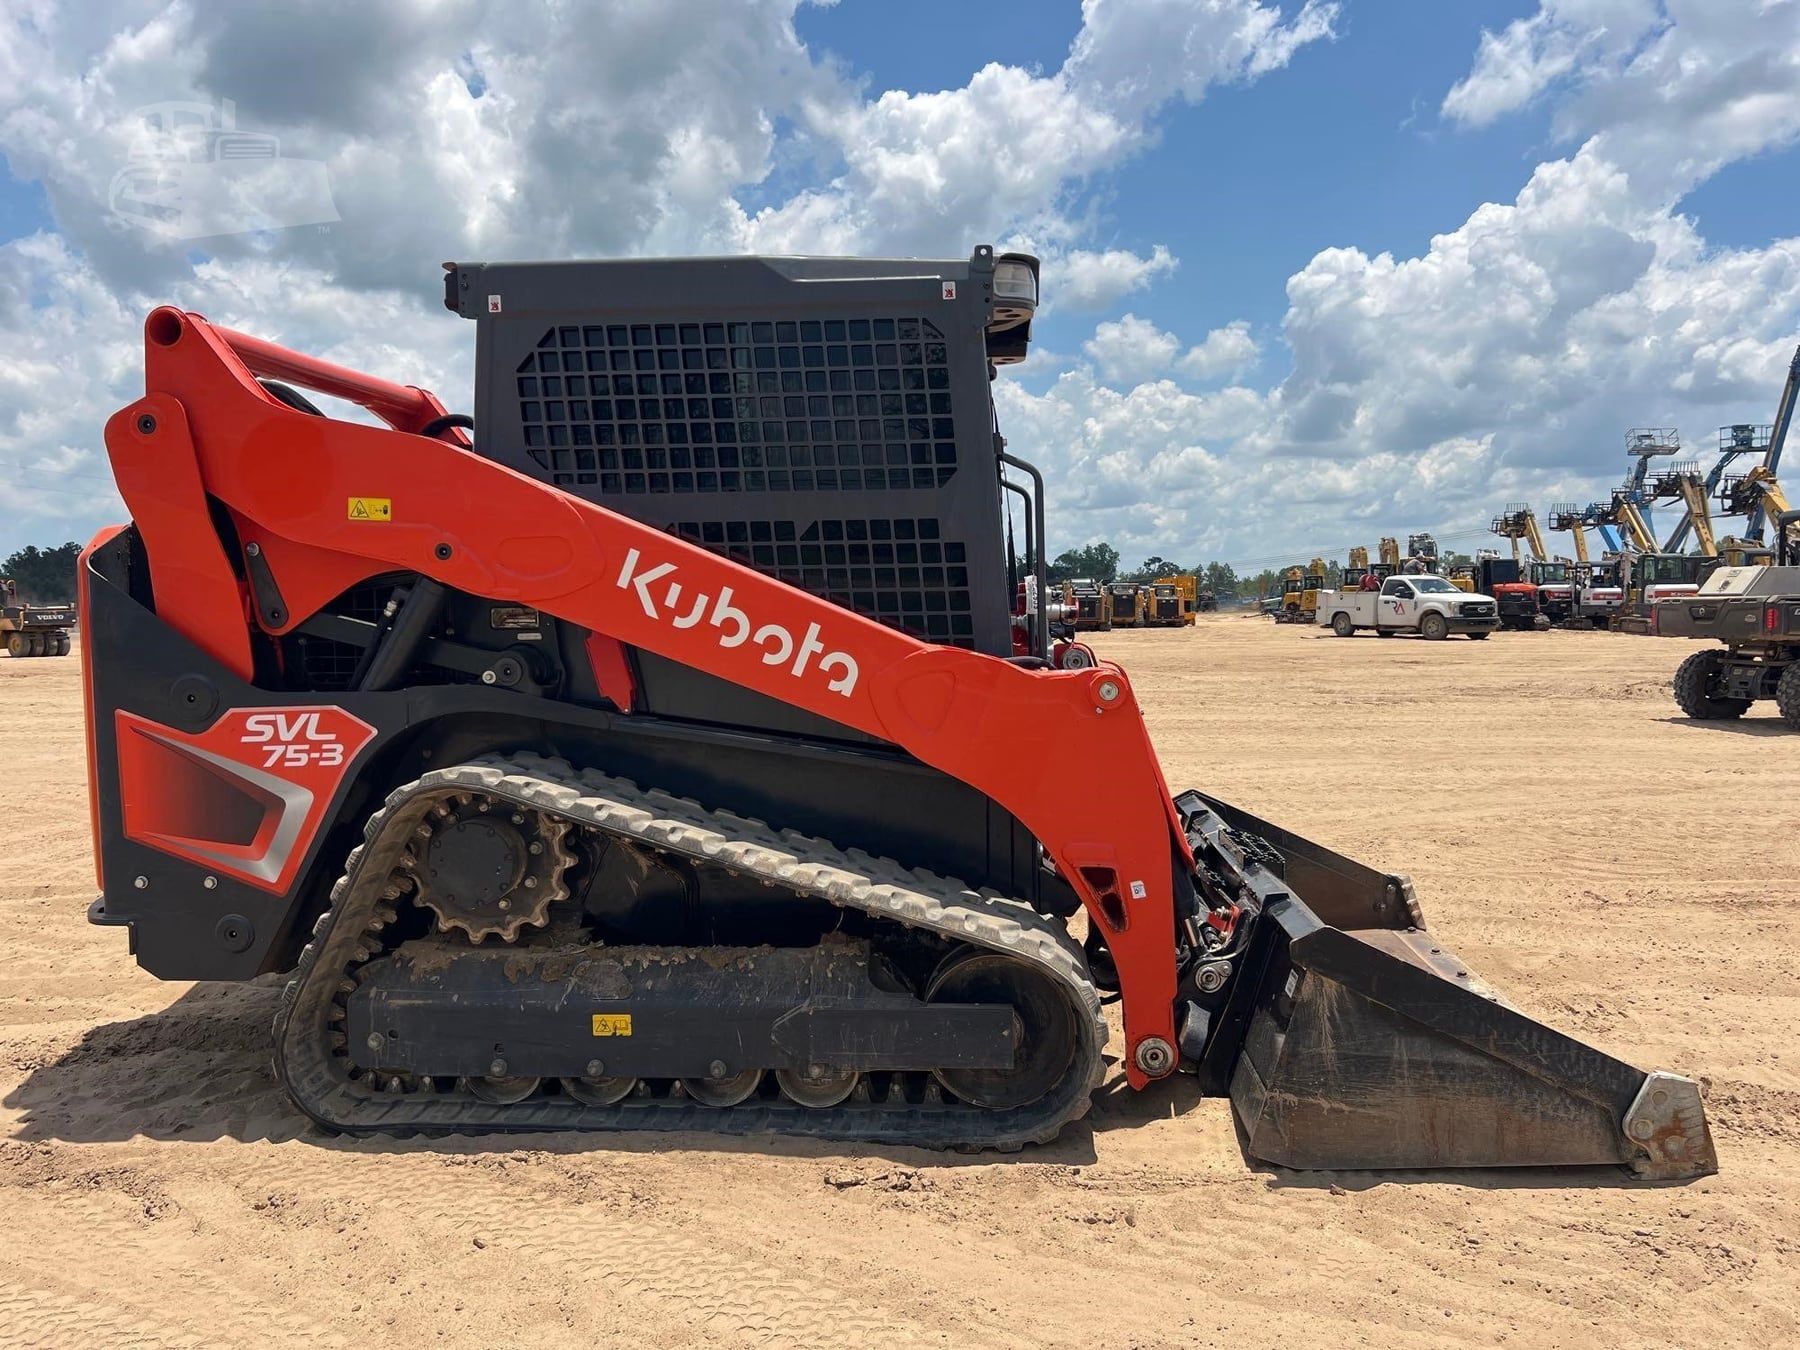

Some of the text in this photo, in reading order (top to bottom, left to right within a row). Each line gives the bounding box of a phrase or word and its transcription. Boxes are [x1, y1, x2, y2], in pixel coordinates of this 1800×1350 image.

[616, 548, 859, 697] Kubota
[240, 713, 337, 743] SVL
[262, 743, 344, 768] 75-3
